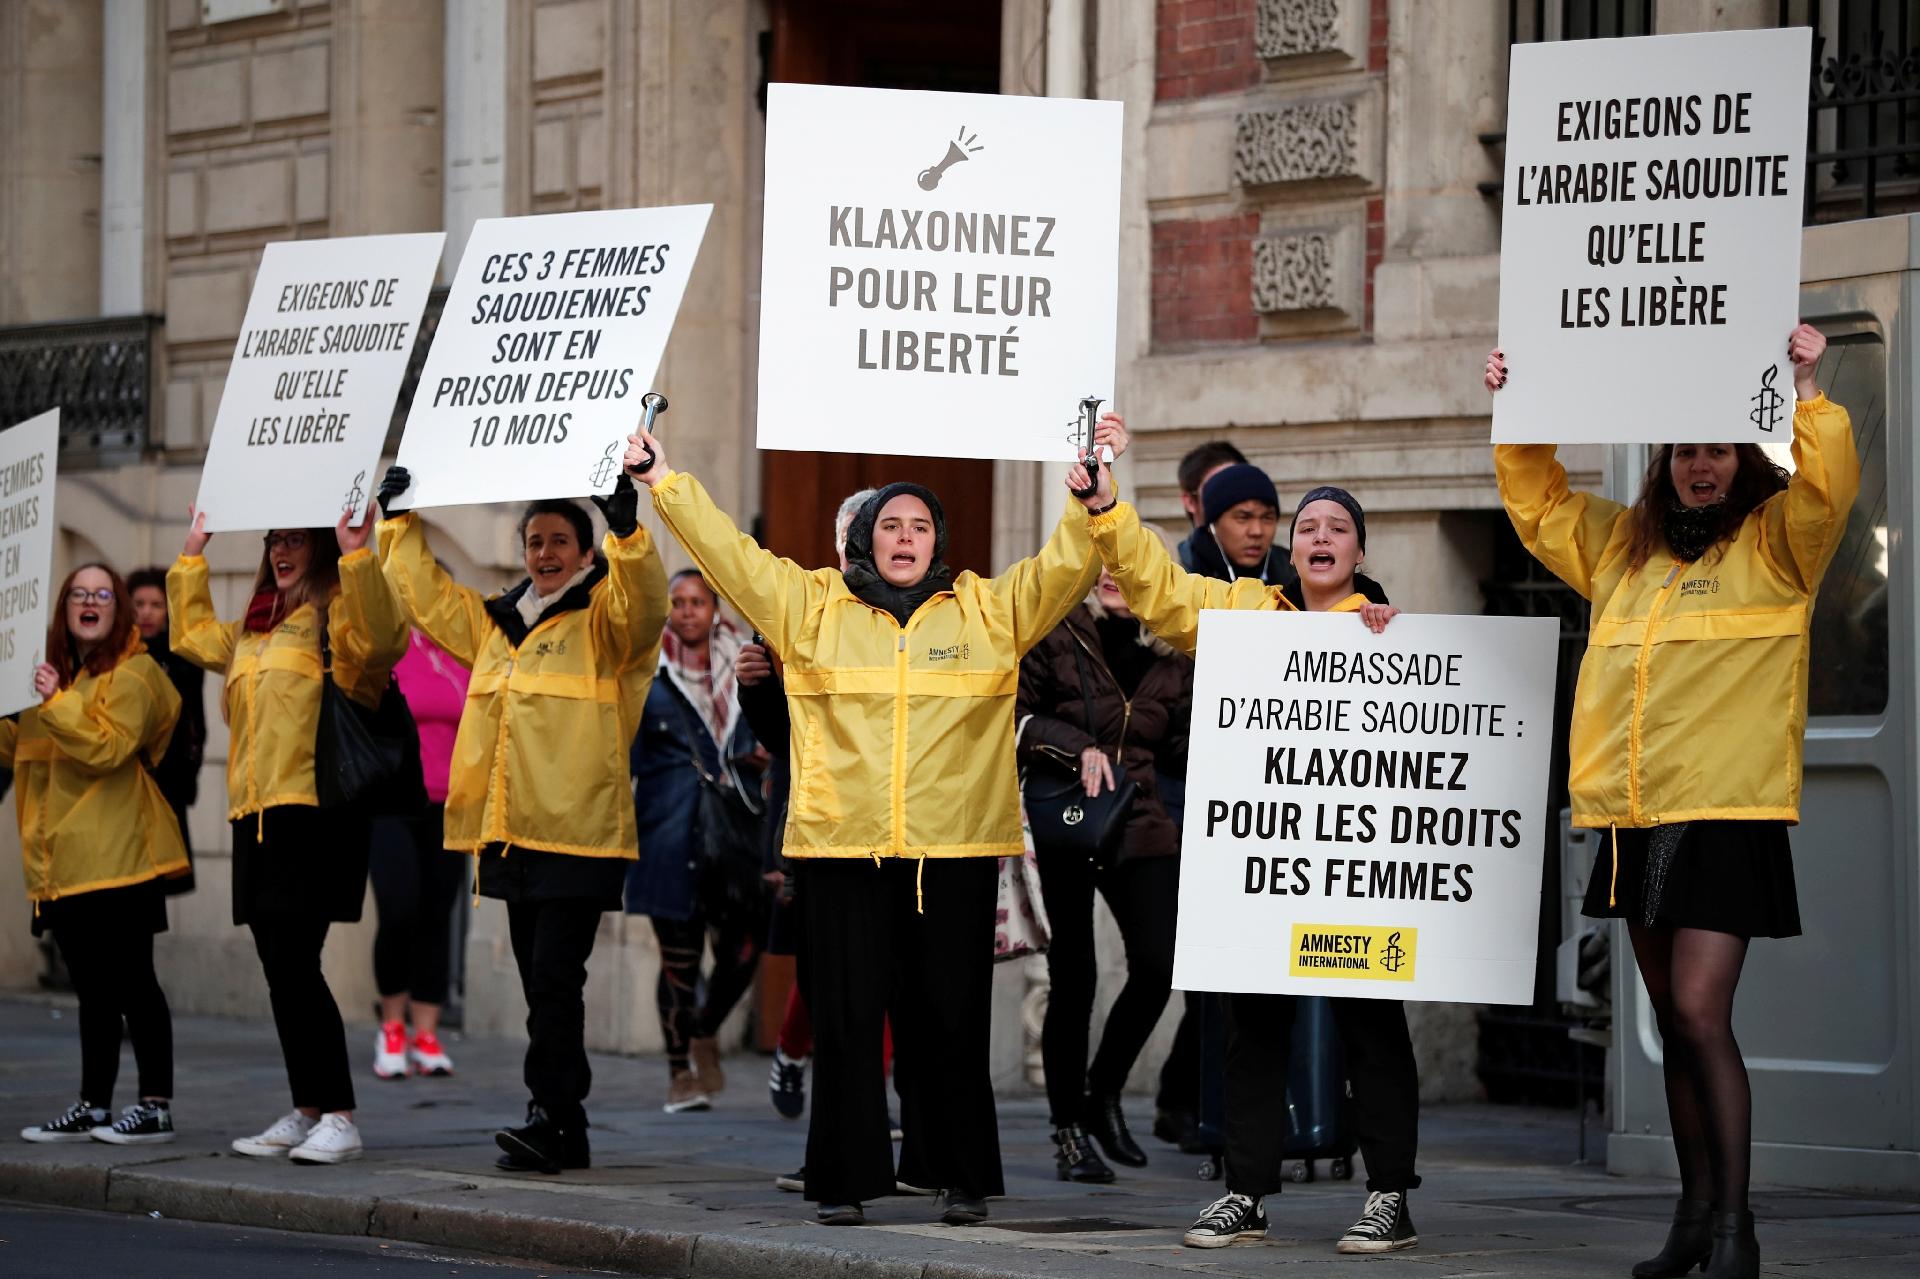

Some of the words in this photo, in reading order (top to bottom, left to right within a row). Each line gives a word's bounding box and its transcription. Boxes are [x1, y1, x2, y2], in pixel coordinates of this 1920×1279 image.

[1556, 94, 1703, 143] EXIGEONS
[1712, 91, 1753, 135] DE
[1516, 160, 1638, 206] L'ARABIE
[1644, 154, 1790, 202] SAOUDITE
[829, 205, 1056, 257] KLAXONNEZ
[1586, 222, 1707, 267] QU'ELLE
[481, 251, 533, 285] CES
[536, 250, 556, 281] 3
[559, 243, 670, 280] FEMMES
[277, 279, 369, 313] EXIGEONS
[369, 278, 400, 308] DE
[471, 286, 652, 325] SAOUDIENNES
[829, 266, 937, 312] POUR
[953, 272, 1051, 318] LEUR
[1560, 286, 1612, 328] LES
[1620, 276, 1728, 327] LIBÈRE
[241, 326, 320, 359] L'ARABIE
[319, 322, 410, 355] SAOUDITE
[491, 329, 563, 364] SONT
[563, 328, 602, 361] EN
[858, 326, 1020, 377] LIBERTÉ
[273, 368, 349, 402] QU'ELLE
[432, 373, 533, 408] PRISON
[534, 368, 634, 403] DEPUIS
[247, 416, 282, 447] LES
[282, 408, 351, 445] LIBÈRE
[469, 415, 501, 448] 10
[503, 413, 573, 446] MOIS
[4, 543, 21, 579] EN
[1283, 650, 1463, 687] AMBASSADE
[1218, 697, 1352, 732] D'ARABIE
[1361, 700, 1507, 738] SAOUDITE
[1264, 746, 1470, 791] KLAXONNEZ
[1206, 799, 1302, 841] POUR
[1315, 803, 1378, 844] LES
[1390, 806, 1524, 850] DROITS
[1244, 856, 1312, 896] DES
[1324, 858, 1474, 904] FEMMES
[1298, 955, 1370, 970] INTERNATIONAL
[1299, 933, 1372, 954] AMNESTY
